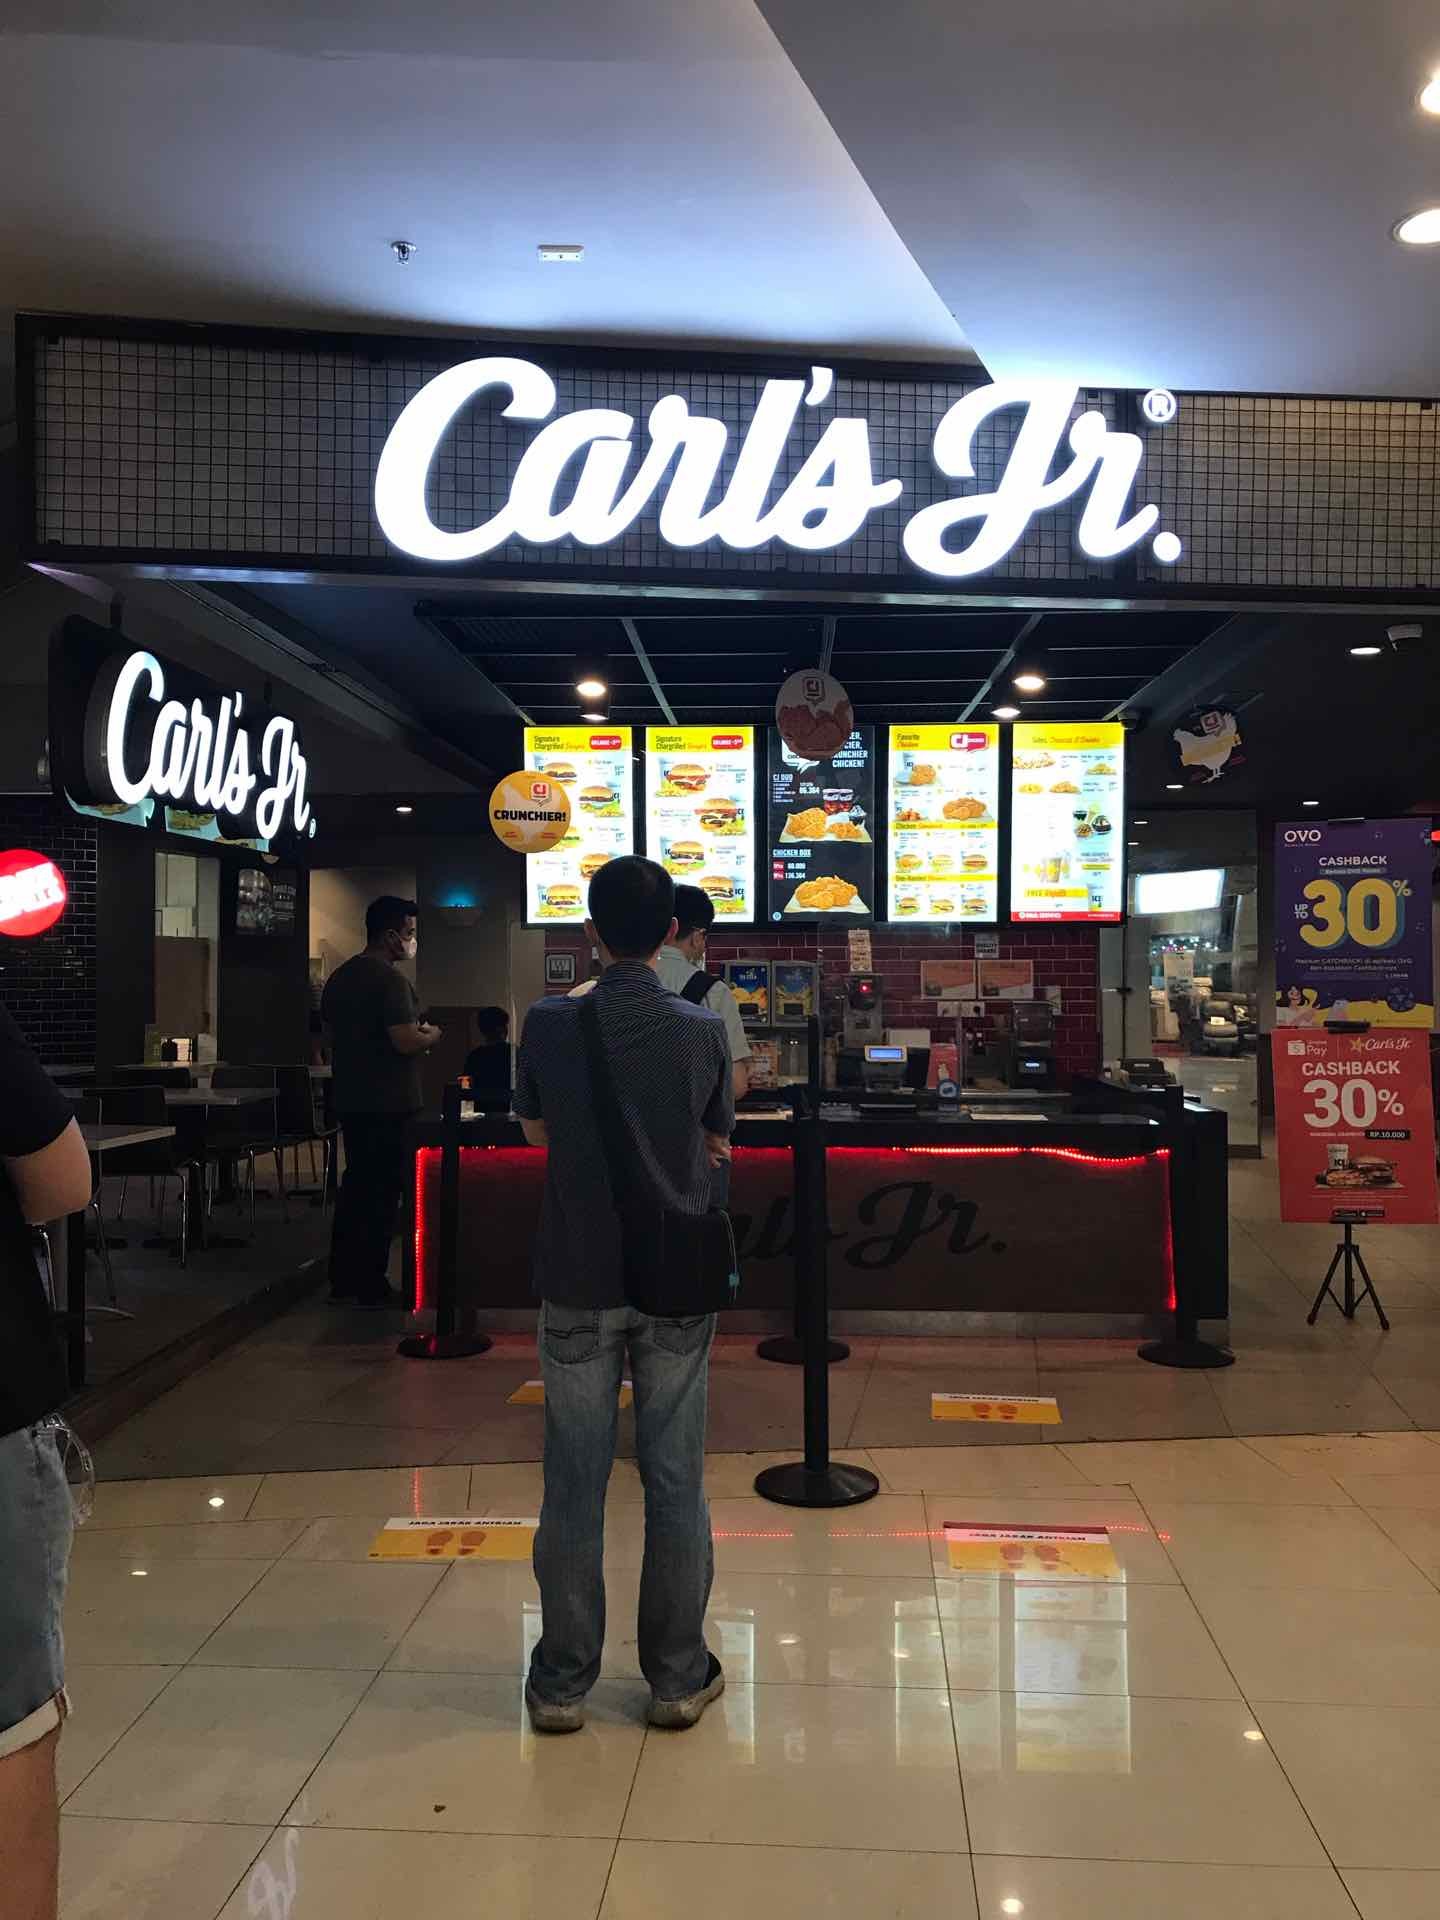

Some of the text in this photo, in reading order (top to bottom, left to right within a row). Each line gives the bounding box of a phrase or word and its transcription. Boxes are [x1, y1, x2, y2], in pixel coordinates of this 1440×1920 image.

[374, 356, 904, 561] Carl's
[107, 651, 255, 814] Carl's
[832, 760, 865, 768] CHICKEN!
[494, 809, 566, 822] CRUNCHIER!
[1284, 829, 1321, 843] OVO
[1318, 855, 1387, 866] CASHBACK
[1294, 904, 1308, 912] UP
[1295, 911, 1309, 919] TO
[1307, 1037, 1412, 1057] Pay Carl's Jr.
[1302, 1061, 1400, 1076] CASHBACK
[1303, 1078, 1405, 1128] 30%
[845, 1181, 1007, 1270] Jr.
